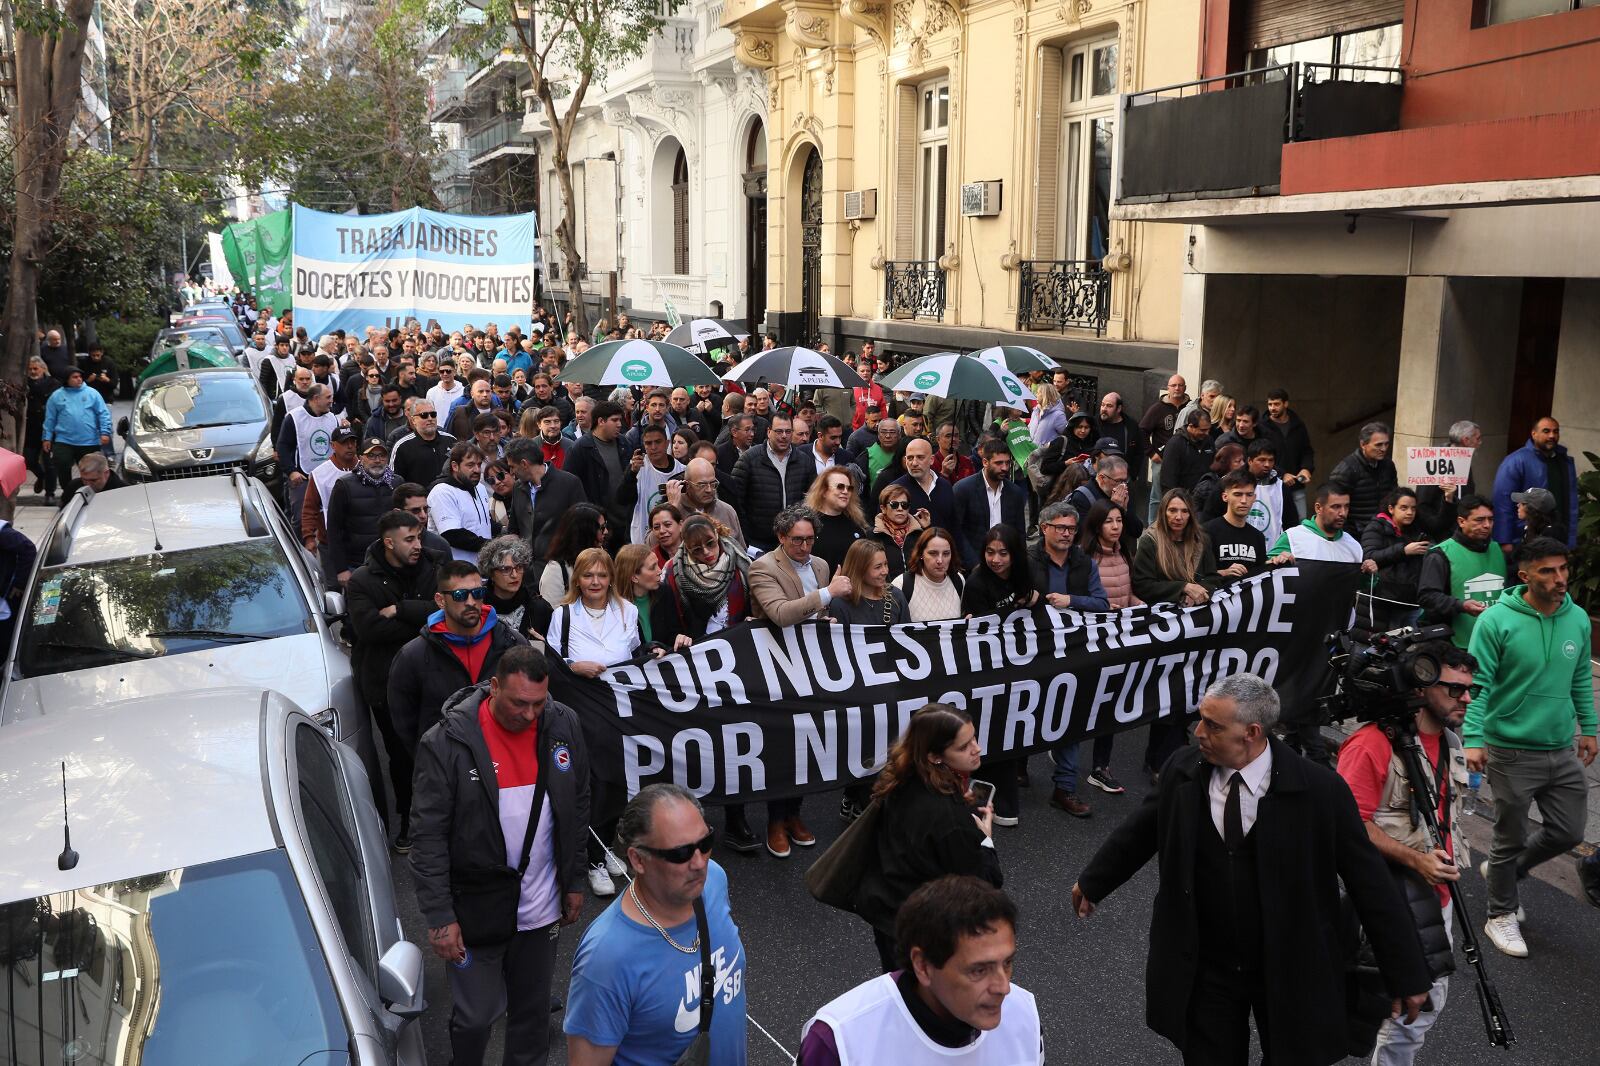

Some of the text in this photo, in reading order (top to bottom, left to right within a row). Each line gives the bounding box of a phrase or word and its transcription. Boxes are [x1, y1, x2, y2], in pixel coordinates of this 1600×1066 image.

[336, 222, 498, 257] TRABAJADORES
[297, 267, 531, 304] DOCENTES Y NODOCENTES
[1426, 458, 1456, 475] UBA
[1219, 543, 1257, 558] FUBA
[600, 566, 1300, 718] POR NUESTRO PRESENTE
[622, 721, 767, 802] POR
[793, 672, 1078, 785] NUTRO
[723, 969, 742, 1004] SB
